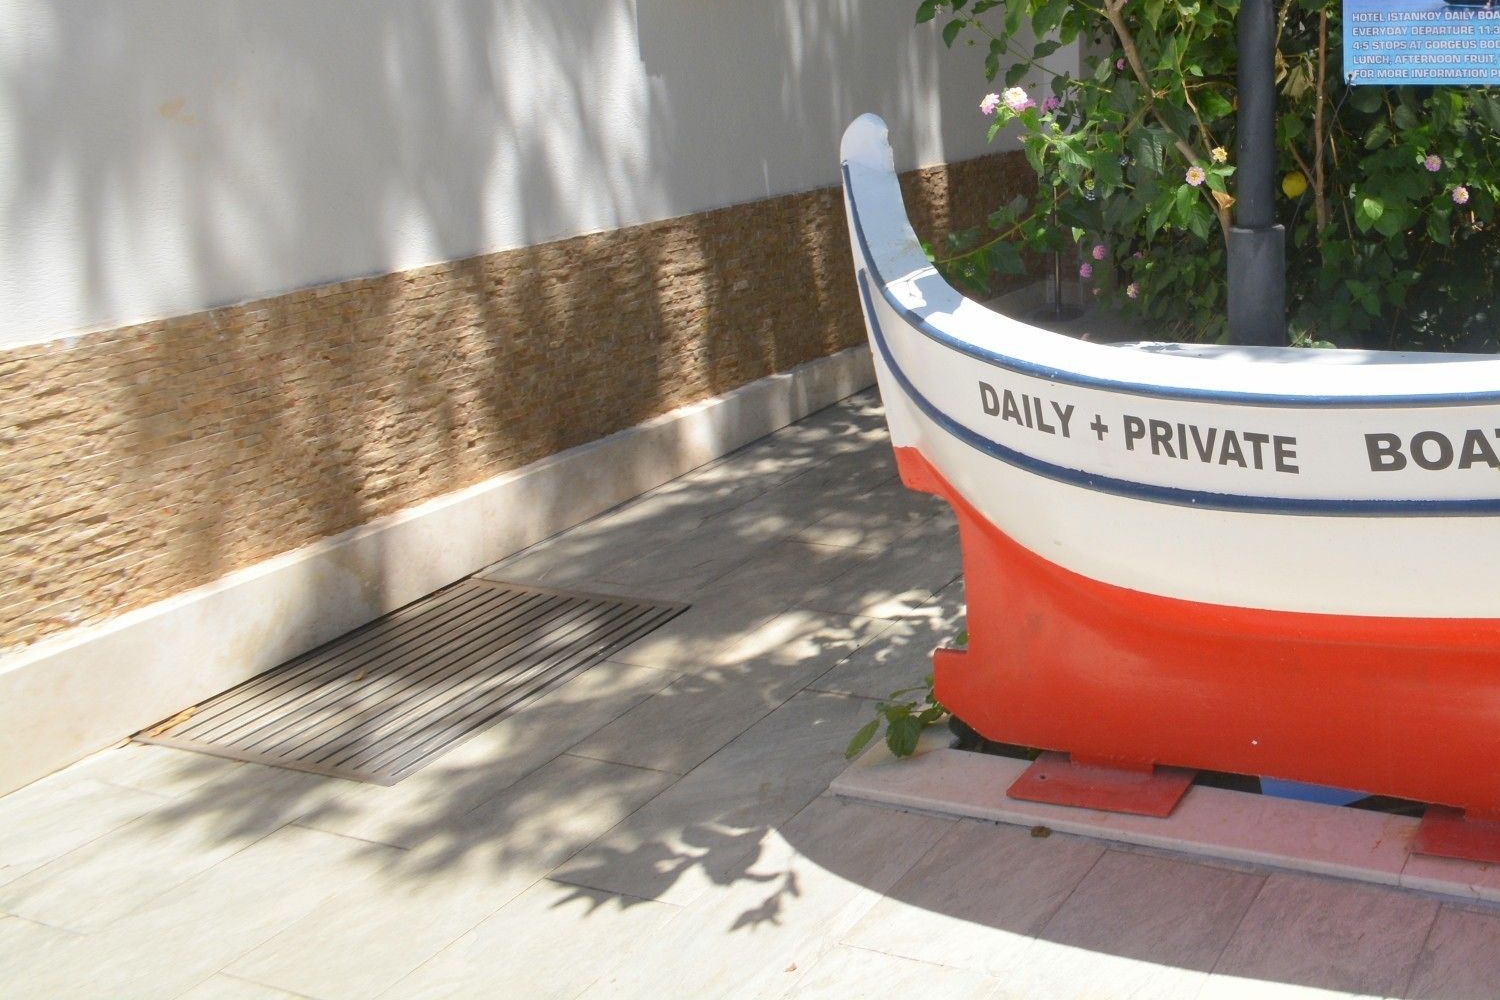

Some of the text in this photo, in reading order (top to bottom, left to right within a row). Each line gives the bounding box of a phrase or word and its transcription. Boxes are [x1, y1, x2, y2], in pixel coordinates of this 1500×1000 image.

[1352, 12, 1384, 22] HOTEL
[1445, 10, 1475, 20] DAILY
[1352, 26, 1408, 36] EVERYDAY
[1411, 25, 1474, 36] DEPARTURE
[1352, 41, 1369, 50] 4-5
[1372, 40, 1407, 50] STOPS
[1409, 40, 1422, 50] AT
[1425, 40, 1477, 49] GORGEUS
[1353, 55, 1392, 65] LUNCH,
[1394, 54, 1461, 64] AFTERNOON
[1464, 54, 1498, 64] FRUIT,
[1354, 69, 1374, 78] FOR
[1377, 69, 1408, 78] MORE
[1411, 68, 1488, 79] INFORMATION
[979, 380, 1074, 438] DAILY
[1090, 414, 1109, 441] +
[1123, 414, 1299, 474] PRIVATE
